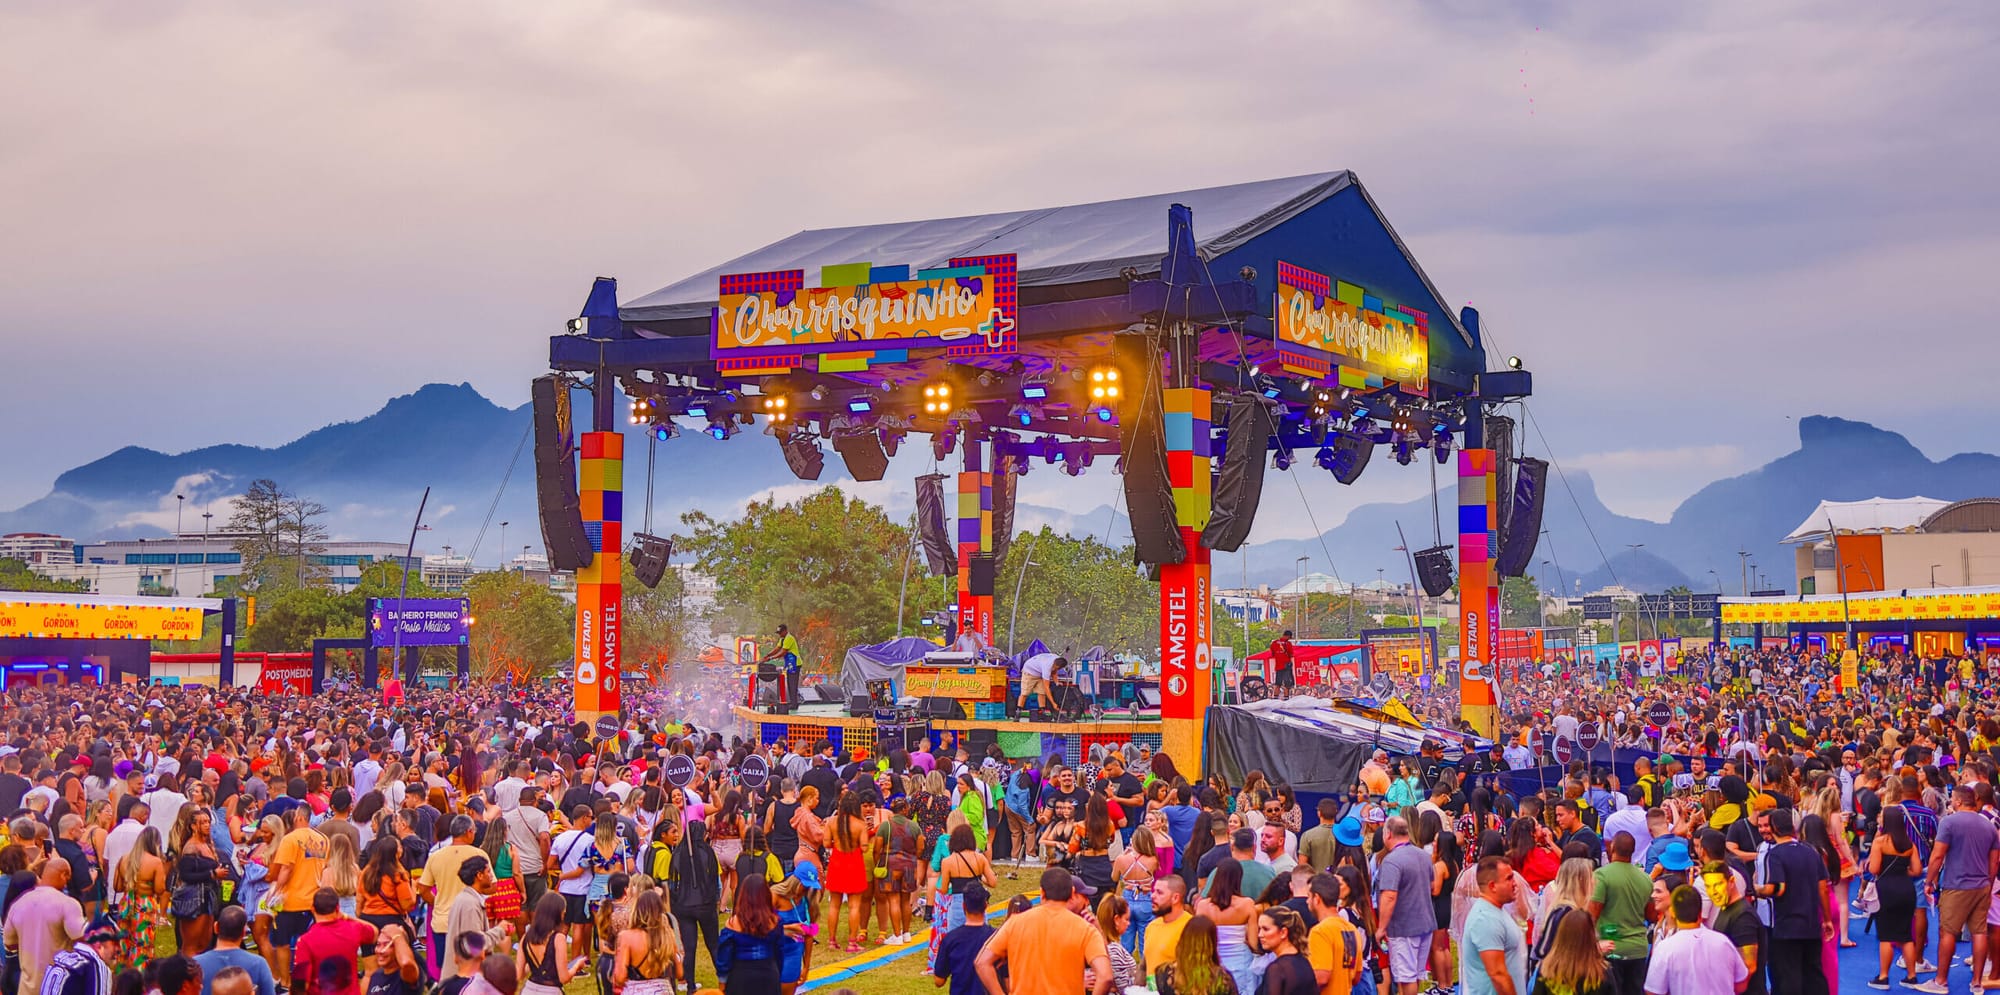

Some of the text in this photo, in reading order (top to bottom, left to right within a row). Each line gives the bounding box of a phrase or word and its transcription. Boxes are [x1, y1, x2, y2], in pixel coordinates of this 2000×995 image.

[401, 620, 421, 633] Posto
[426, 611, 458, 620] FEMININO
[1169, 587, 1186, 670] AMSTEL
[1198, 577, 1206, 639] BETANO
[582, 610, 591, 659] BETANO
[604, 602, 616, 670] AMSTEL
[1467, 612, 1477, 658] BETANO
[668, 766, 691, 775] CAIXA
[742, 768, 764, 776] CAIXA
